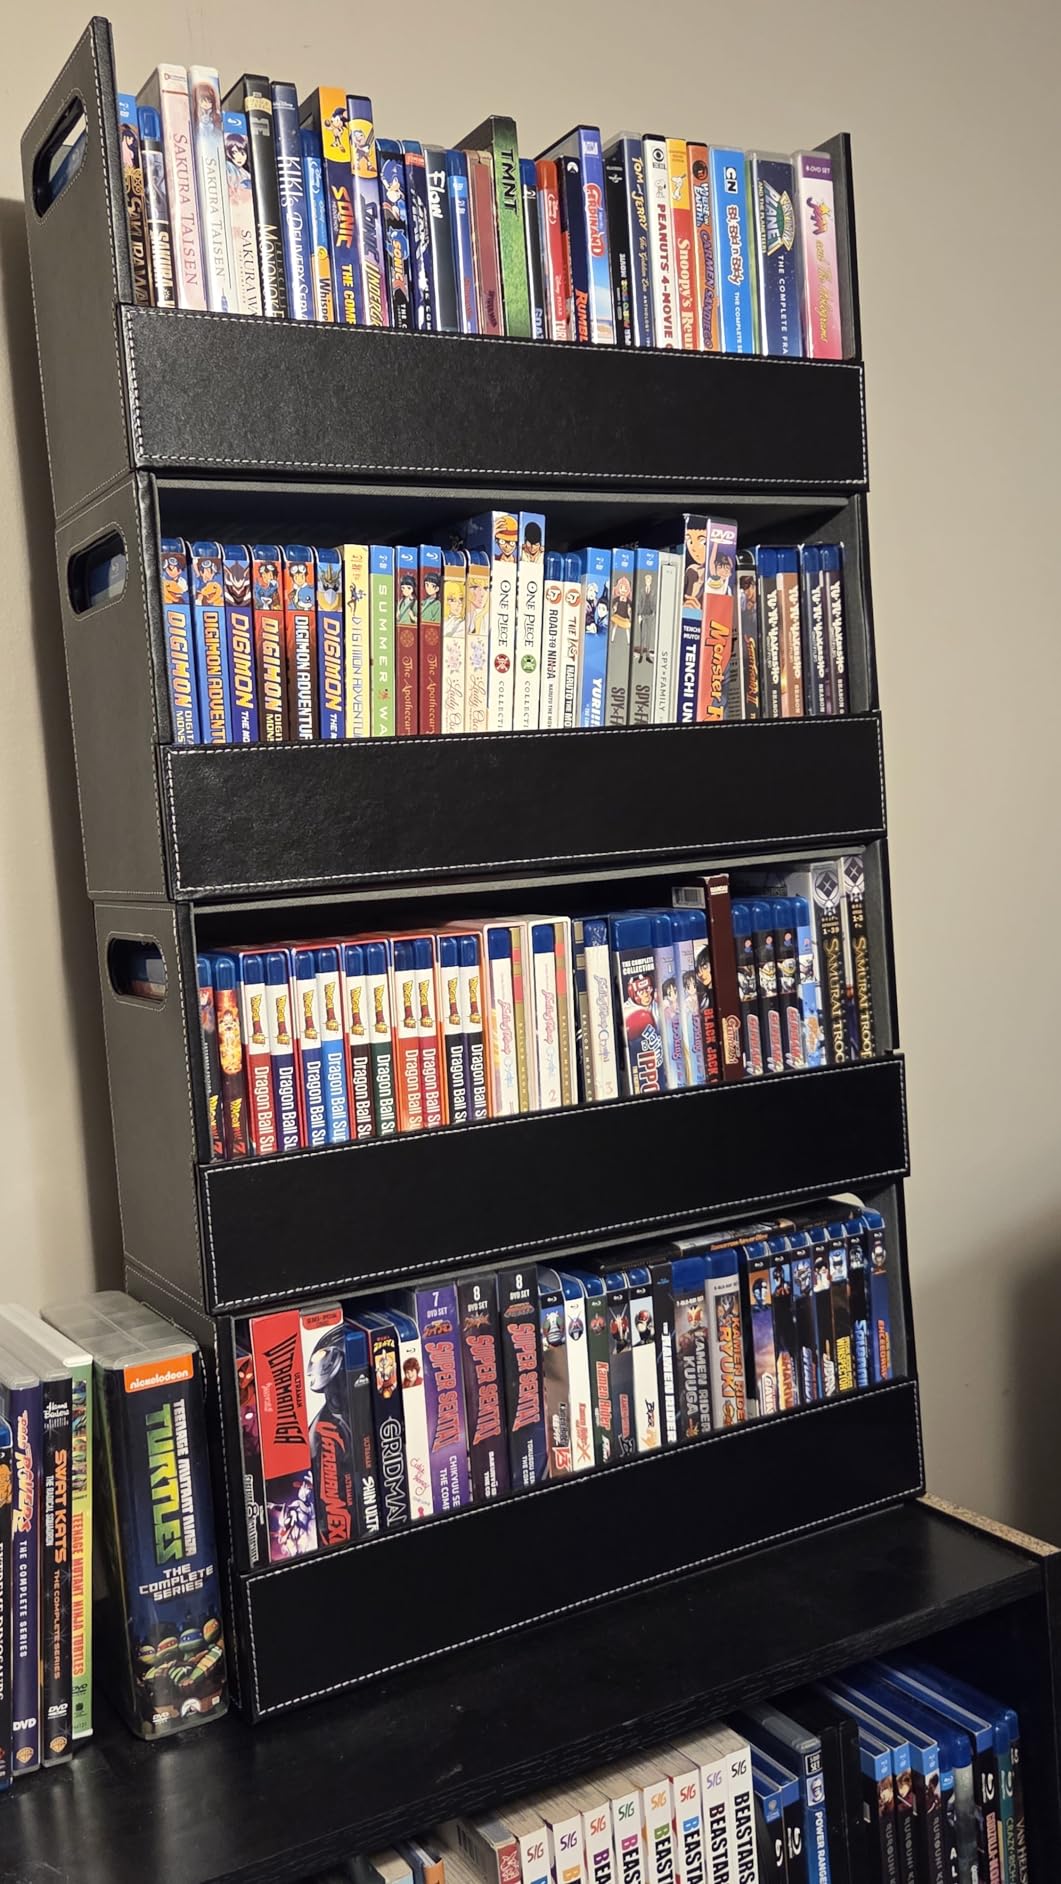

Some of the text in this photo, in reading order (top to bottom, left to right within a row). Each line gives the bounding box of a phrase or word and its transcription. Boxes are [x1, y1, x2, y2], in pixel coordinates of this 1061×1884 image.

[174, 133, 198, 287] SAKURA TAISEN
[501, 149, 518, 216] TMNT
[631, 157, 648, 231] TOM JERRY
[725, 167, 737, 193] CN
[204, 157, 227, 278] SAKURA TAISEN
[331, 185, 355, 249] SONIC
[584, 184, 605, 255] FERDINAND
[765, 186, 782, 251] PLANET
[240, 229, 257, 293] SAKURA
[342, 264, 354, 287] THE
[392, 241, 405, 281] SONIC
[619, 253, 627, 278] MOVIE
[656, 203, 674, 339] PEANUTS 4-MOVIE
[677, 238, 694, 307] Snoopy's
[700, 230, 715, 349] CARMEN SANDIEGO
[735, 305, 743, 343] COMPLETE
[779, 278, 788, 332] COMPLETE
[710, 529, 735, 541] DVD
[203, 612, 222, 675] DIGIMON
[295, 616, 311, 670] DIGIMON
[378, 584, 388, 682] SUMMER
[497, 580, 512, 648] ONE PIECE
[523, 580, 538, 648] ONE PIECE
[546, 609, 558, 680] ROAD NINJA
[167, 611, 193, 708] DIGIMON
[231, 613, 254, 731] DIGIMON THE
[261, 617, 282, 712] DIGIMON
[323, 617, 342, 731] DIGIMON THE
[565, 616, 577, 711] THE NARUTO THE
[683, 643, 697, 698] TENCHI
[704, 620, 731, 701] Monster
[621, 960, 633, 968] THE
[823, 938, 843, 1016] SAMURAI
[853, 937, 870, 1009] SAMURAI
[703, 1008, 719, 1075] BLACK JACK
[254, 1066, 273, 1134] Dragon Ball
[279, 1066, 298, 1133] Dragon Ball
[306, 1061, 324, 1128] Dragon Ball
[327, 1052, 346, 1121] Dragon Ball
[352, 1056, 371, 1123] Dragon Ball
[375, 1054, 394, 1120] Dragon Ball
[404, 1049, 421, 1114] Dragon Ball
[421, 1048, 439, 1113] Dragon Ball
[450, 1045, 466, 1109] Dragon Ball
[470, 1044, 487, 1107] Dragon Ball
[426, 1307, 448, 1318] DVD SET
[432, 1292, 439, 1307] 7
[473, 1285, 481, 1300] 8
[478, 1300, 488, 1311] SET
[515, 1274, 523, 1290] 8
[519, 1289, 530, 1299] SET
[507, 1323, 541, 1432] SUPER SENTAI
[595, 1360, 610, 1399] Kamen
[718, 1326, 736, 1397] RYUKI
[731, 1318, 743, 1376] KAMEN
[836, 1336, 853, 1391] WINSPECTOR
[130, 1370, 189, 1390] nickelodeon
[293, 1372, 303, 1408] ULTRAMAN
[424, 1341, 461, 1453] SUPER SENTAI
[466, 1335, 501, 1446] SUPER SENTAI
[682, 1355, 699, 1415] KUUGA
[694, 1330, 711, 1432] KAMEN RIDER
[597, 1399, 612, 1430] Rider
[12, 1451, 34, 1534] ROVERS
[145, 1404, 183, 1565] TURTLES
[173, 1399, 197, 1557] TEENAGE MUTANT NINJA
[314, 1421, 346, 1501] ULTRAMAN
[362, 1475, 377, 1505] SHIN
[440, 1467, 448, 1485] THE
[449, 1455, 459, 1494] CHIKYUU
[46, 1475, 54, 1546] THE RADICAL SQUADRON
[54, 1449, 67, 1563] SWAT KATS
[18, 1540, 28, 1658] THE COMPLETE SERIES
[53, 1569, 61, 1589] THE
[72, 1512, 85, 1676] TEENAGE MUTANT NINJA TURTLES
[139, 1565, 214, 1595] COMPLETE
[153, 1579, 204, 1601] SERIES
[163, 1563, 191, 1579] THE
[53, 1640, 61, 1679] SERIES
[12, 1717, 37, 1731] DVD
[48, 1703, 69, 1713] DVD
[814, 1811, 825, 1849] POWER
